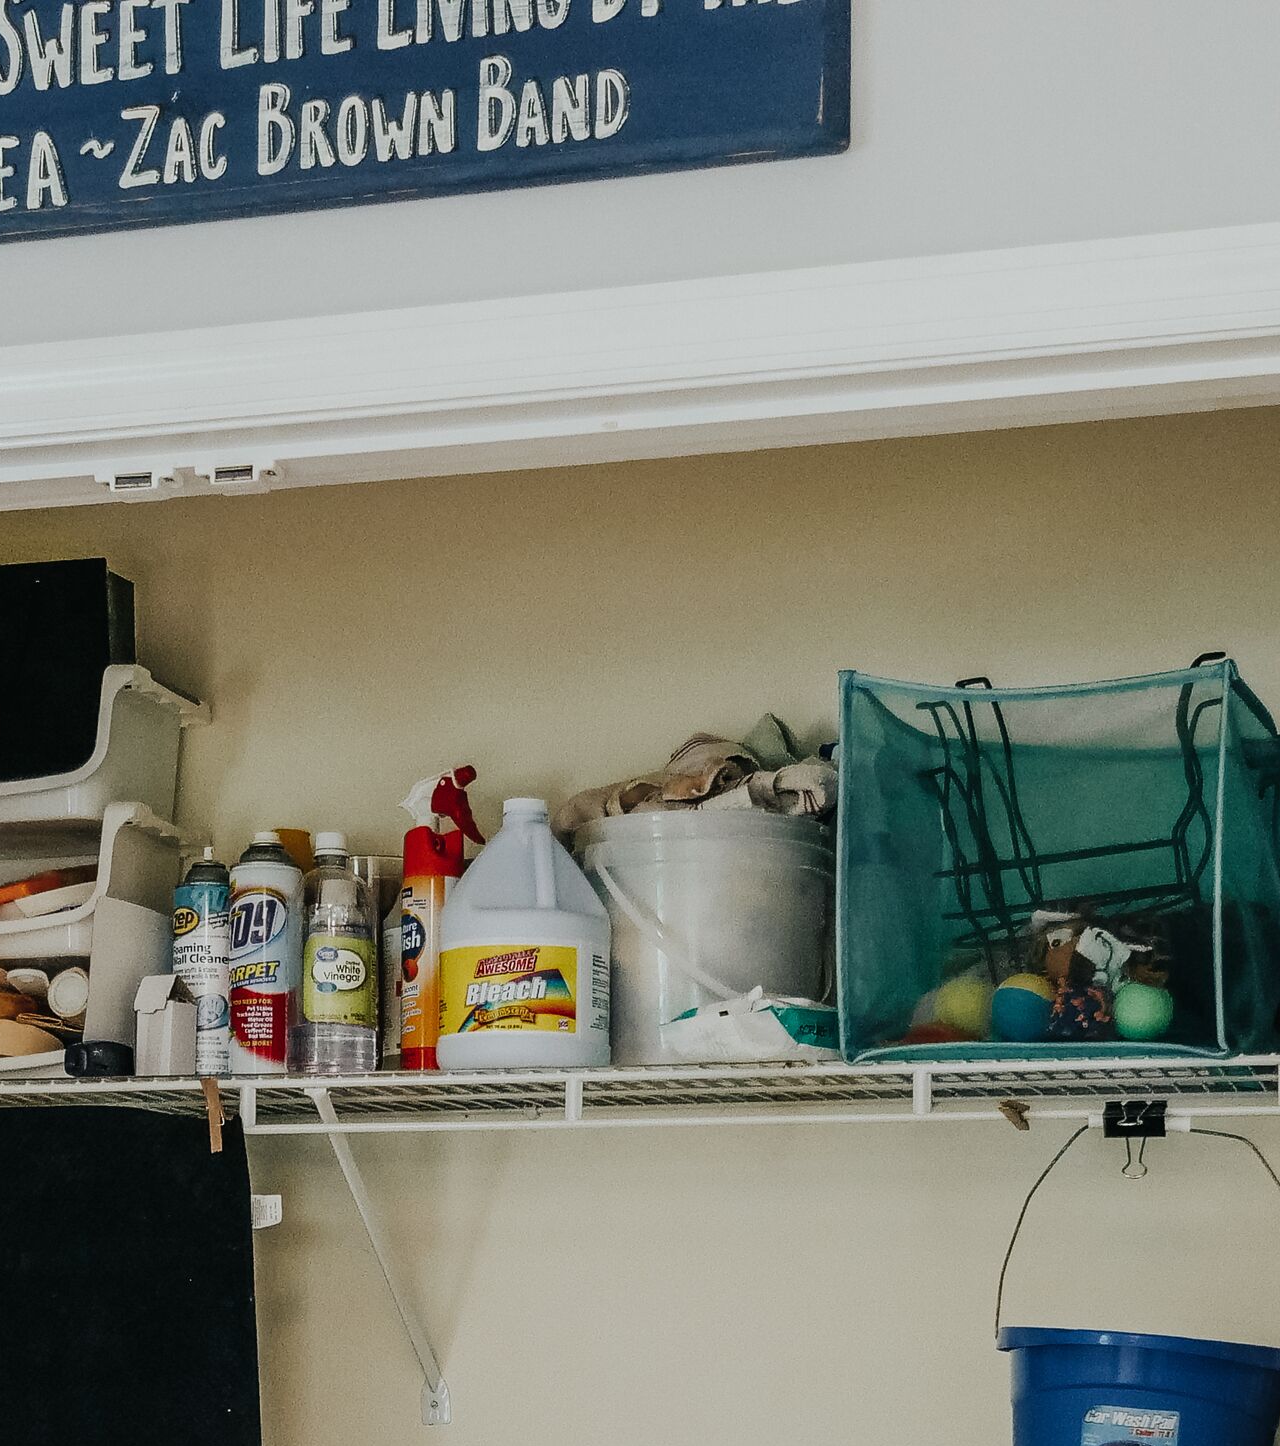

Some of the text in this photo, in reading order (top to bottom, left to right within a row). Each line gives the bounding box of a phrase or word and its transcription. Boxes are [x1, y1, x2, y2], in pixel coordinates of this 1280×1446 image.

[220, 0, 356, 70] LIFE
[257, 82, 456, 177] BROWN
[476, 54, 630, 153] BAND
[230, 899, 279, 950] 09
[323, 971, 361, 983] Vinegar
[335, 964, 361, 974] White
[476, 956, 534, 976] AWESOME
[466, 976, 547, 1006] Bleach
[1084, 1409, 1178, 1430] Car Wash Pad
